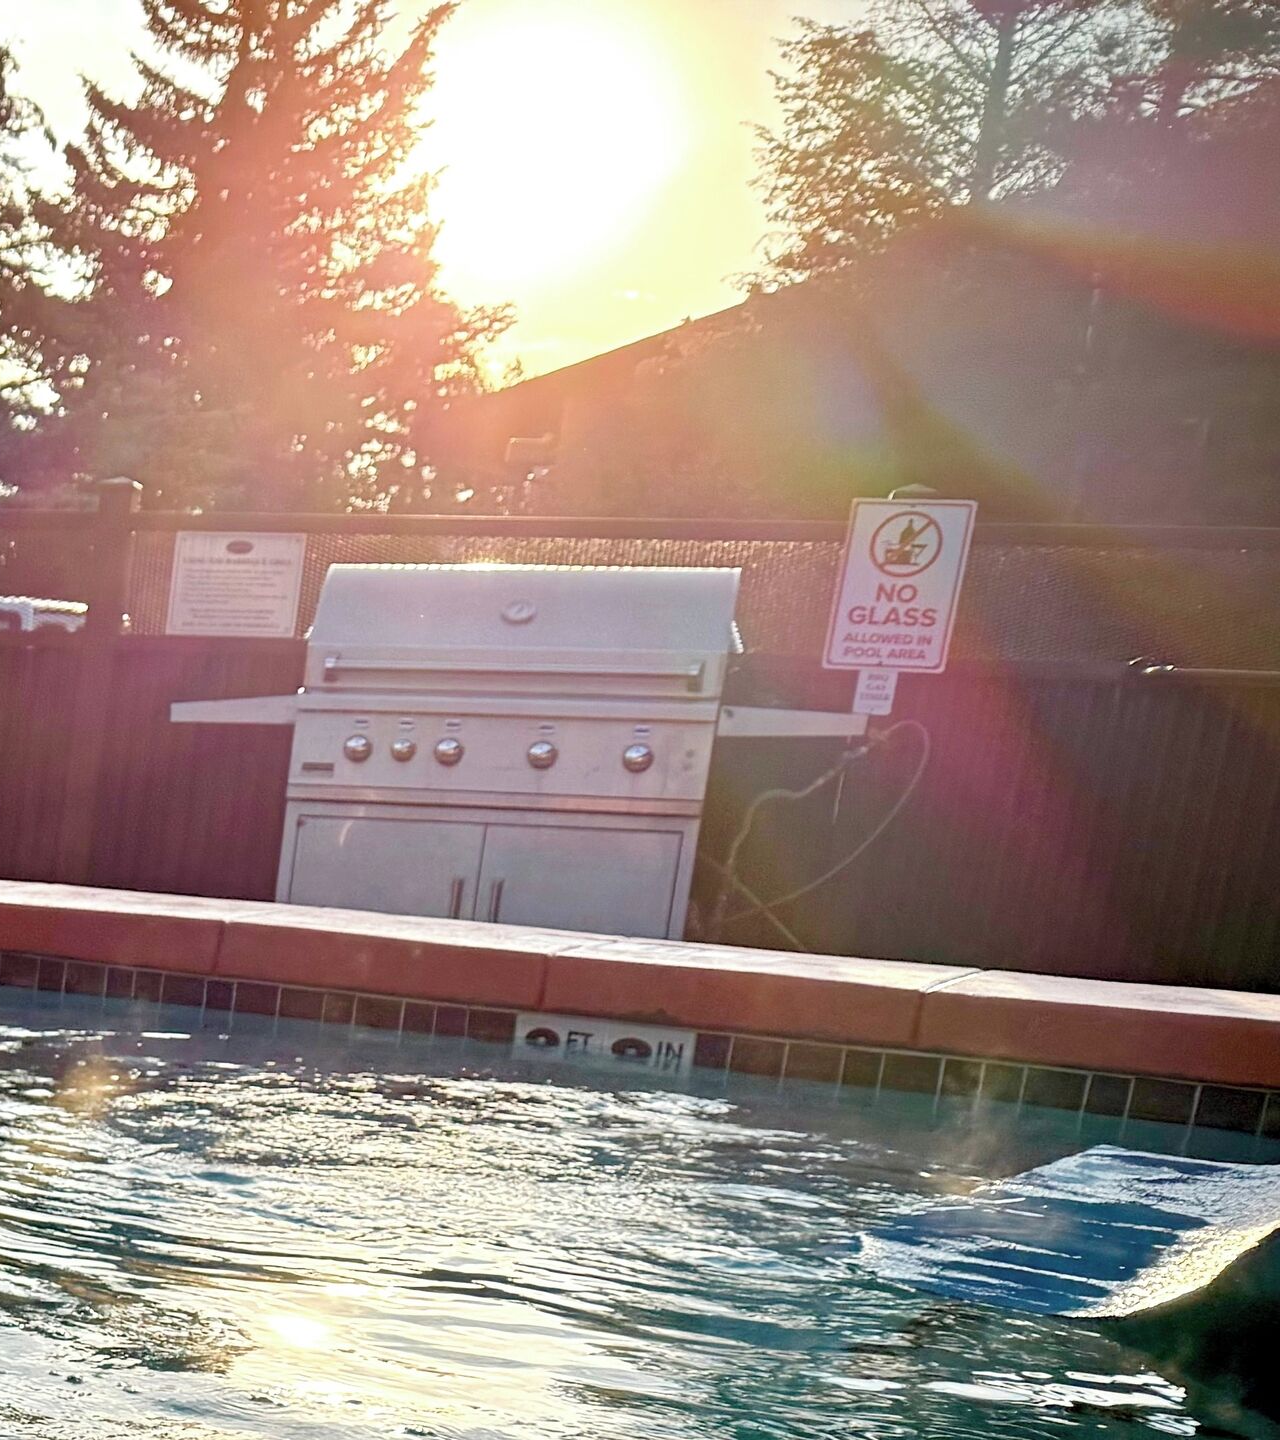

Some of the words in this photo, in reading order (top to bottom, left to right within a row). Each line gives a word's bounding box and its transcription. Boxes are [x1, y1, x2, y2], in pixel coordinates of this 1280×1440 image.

[876, 583, 918, 603] NO
[848, 605, 938, 627] GLASS
[843, 632, 914, 645] ALLOWED
[916, 634, 934, 646] IN
[843, 646, 882, 658] POOL
[887, 648, 926, 660] AREA
